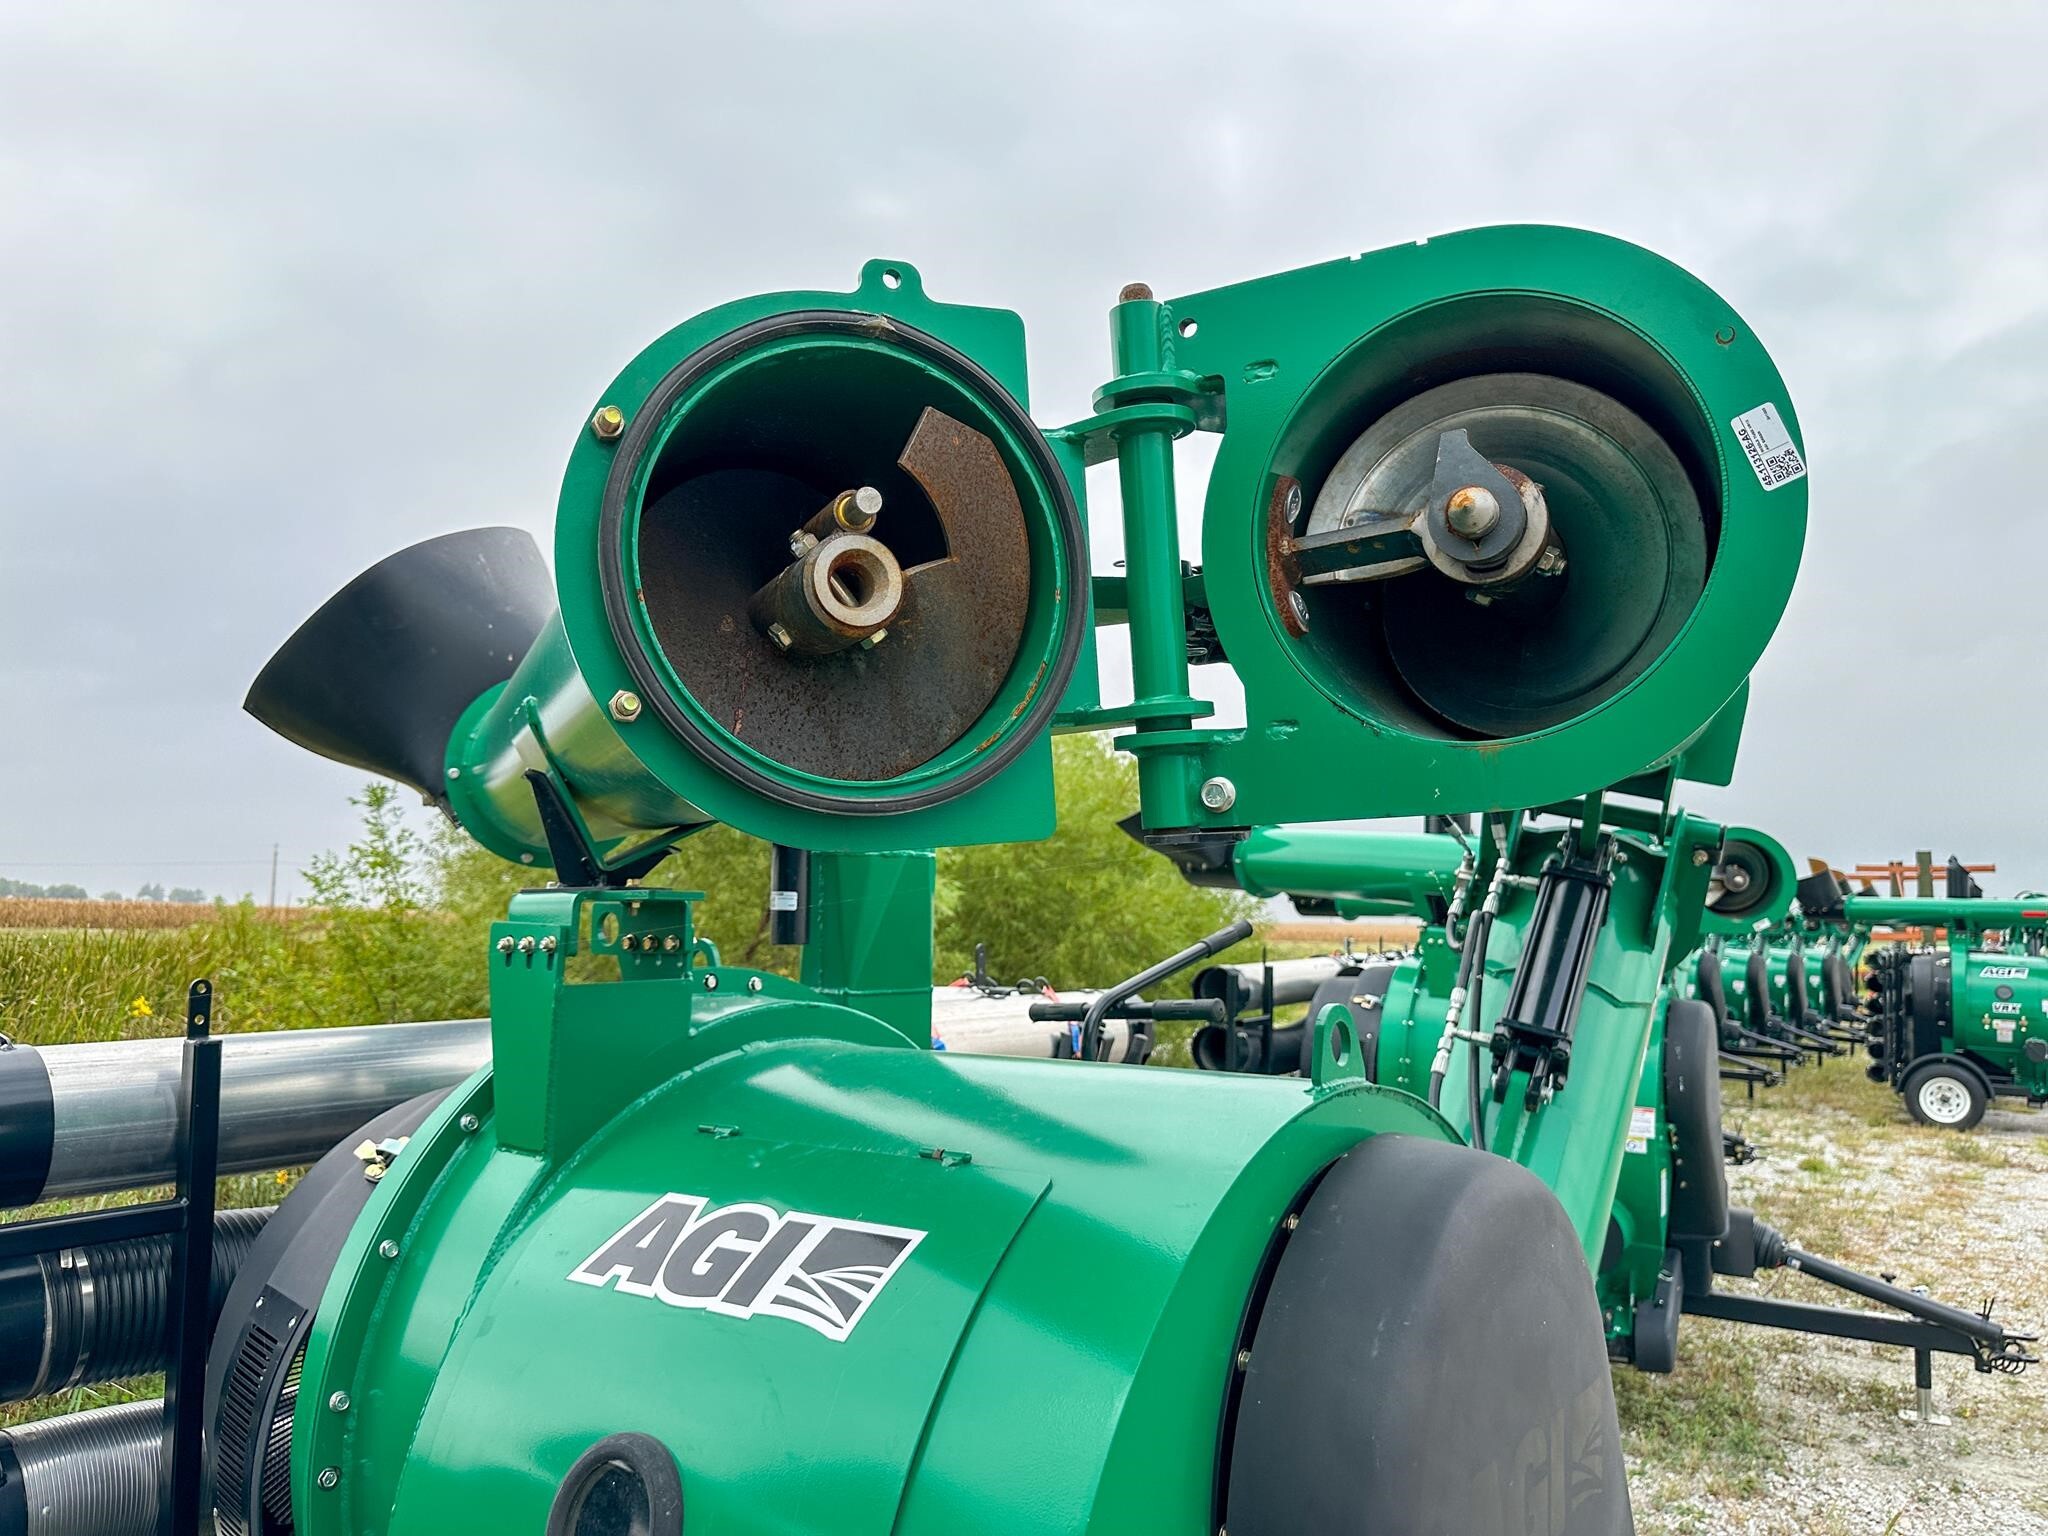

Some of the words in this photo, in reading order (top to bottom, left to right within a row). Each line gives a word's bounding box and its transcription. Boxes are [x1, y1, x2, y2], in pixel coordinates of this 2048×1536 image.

[1738, 428, 1772, 486] 45-113126-AG
[1982, 966, 2013, 976] AGI
[576, 1196, 818, 1311] AGI
